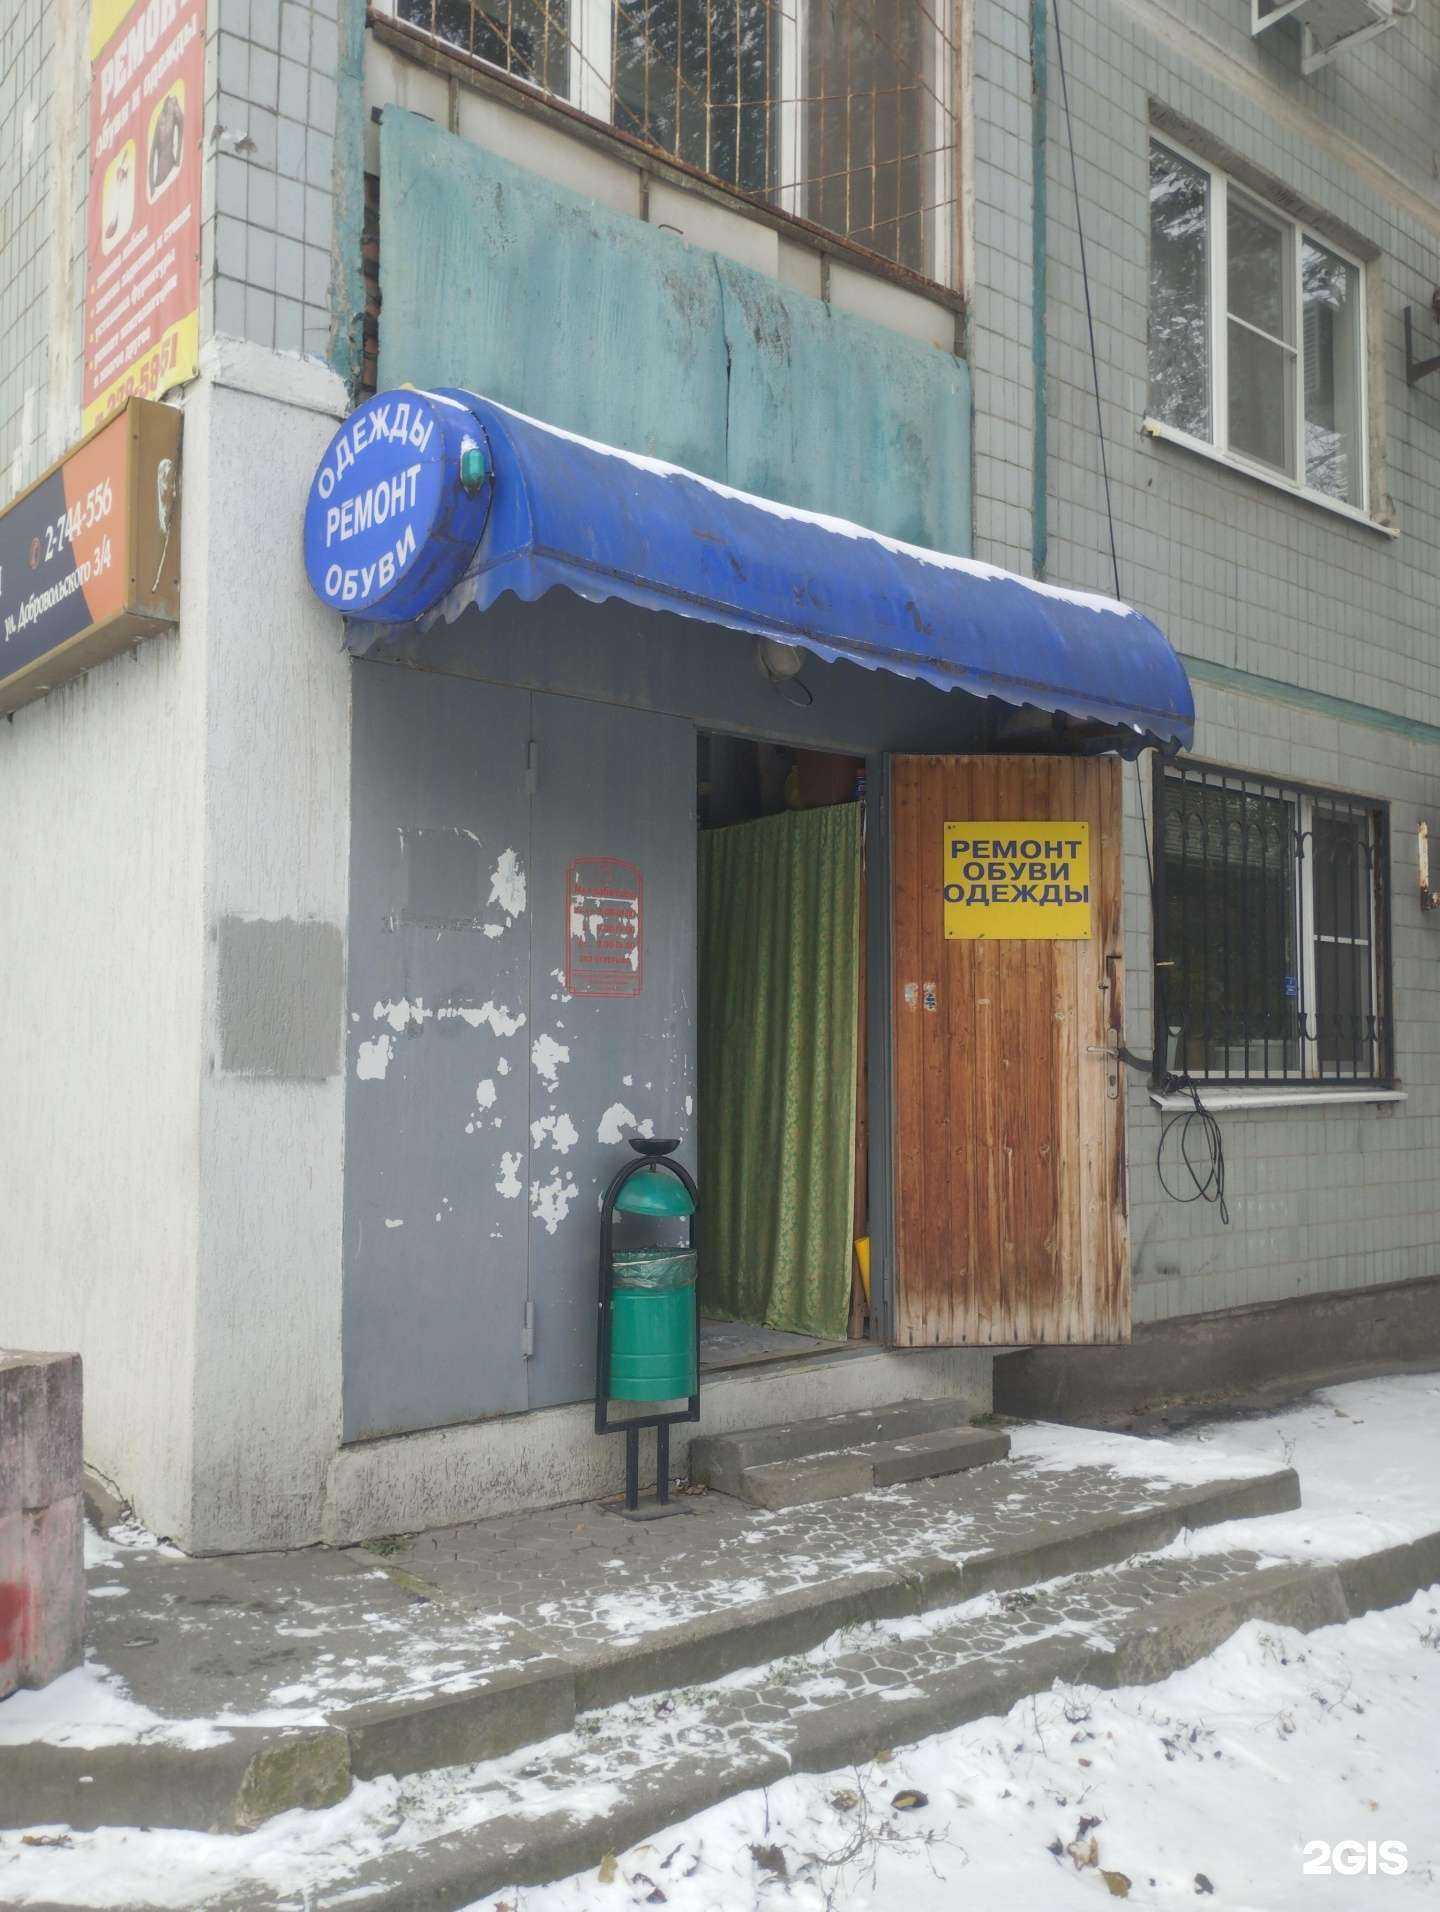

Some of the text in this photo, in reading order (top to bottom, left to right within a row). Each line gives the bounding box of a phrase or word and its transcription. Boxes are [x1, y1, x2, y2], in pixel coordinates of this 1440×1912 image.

[101, 0, 189, 115] РЕМОН
[318, 403, 434, 499] ОДЕЖДЫ
[44, 477, 113, 563] 2-744-556
[326, 463, 421, 548] РЕМОНТ
[17, 560, 91, 632] Добровольского
[93, 534, 112, 577] 3/4
[325, 523, 416, 600] ОБУВИ
[951, 840, 1082, 859] РЕМОНТ
[963, 861, 1070, 881] ОБУВИ
[944, 884, 1089, 906] ОДЕЖДЫ
